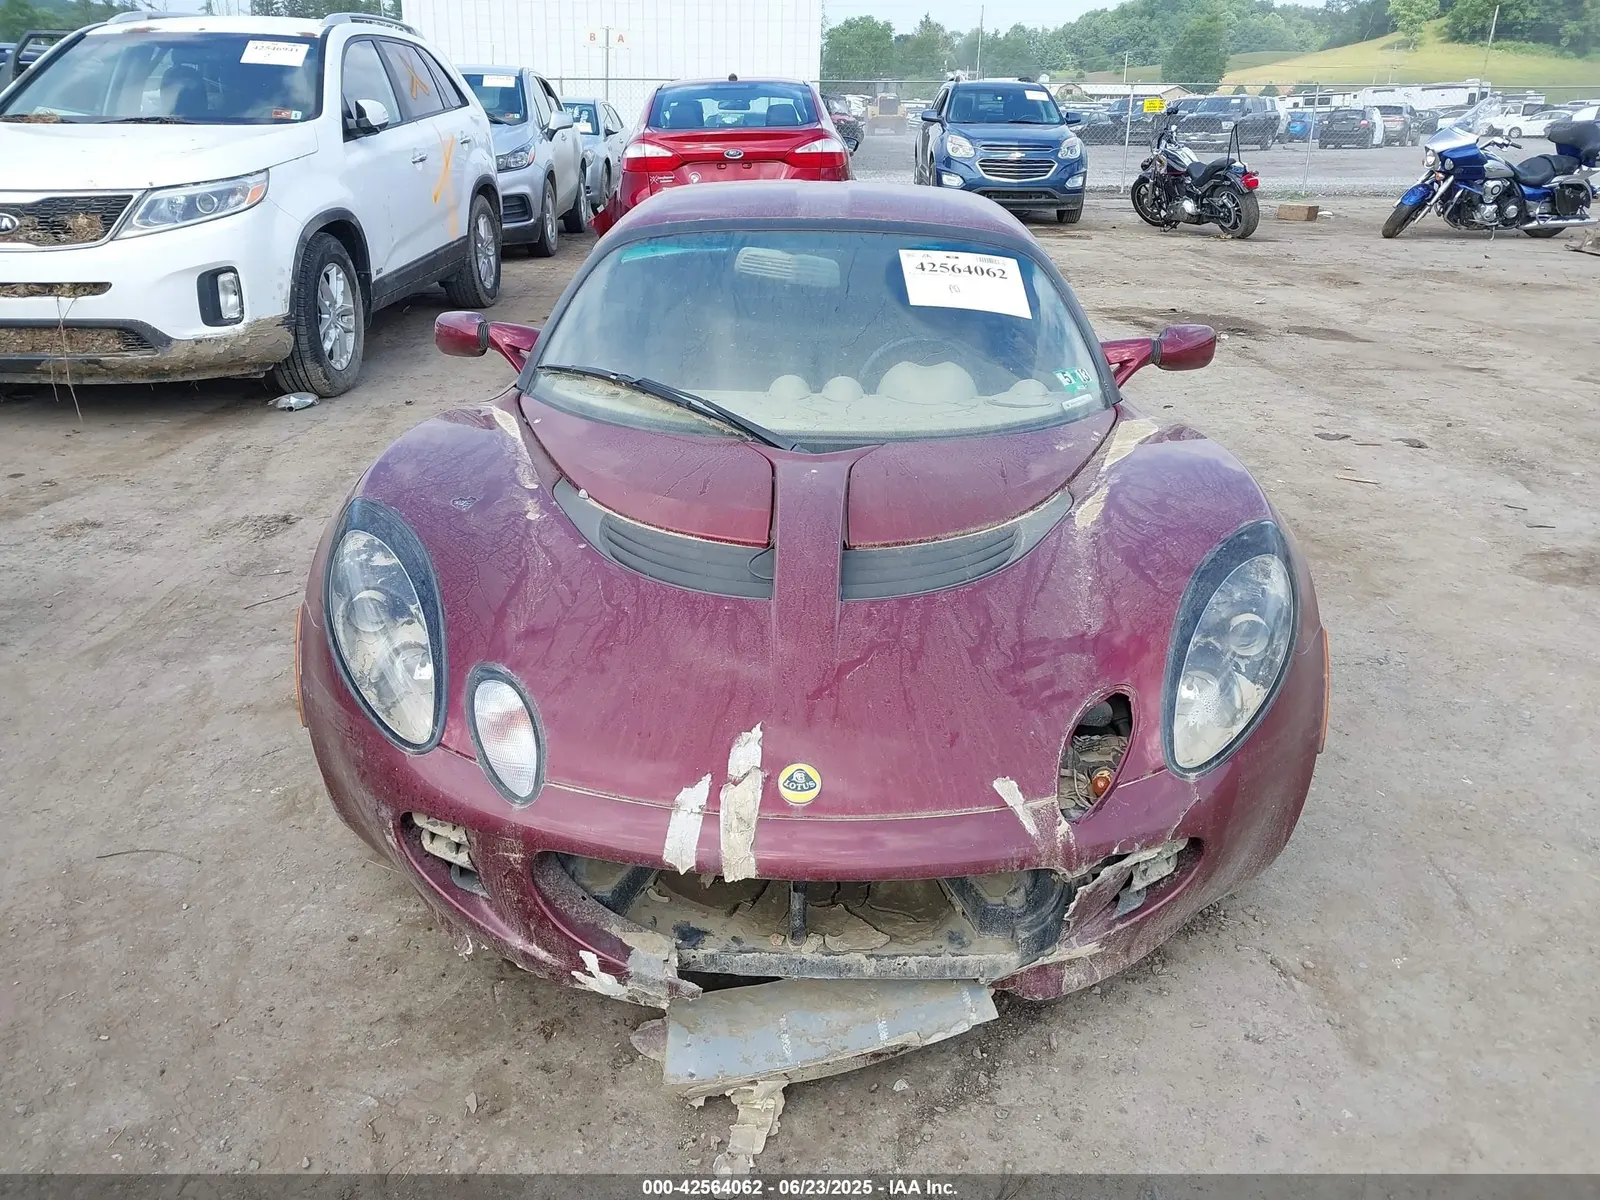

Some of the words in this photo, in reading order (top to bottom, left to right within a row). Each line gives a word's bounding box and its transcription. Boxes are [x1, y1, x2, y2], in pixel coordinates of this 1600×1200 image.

[589, 32, 596, 41] B
[617, 34, 624, 43] A
[915, 262, 1008, 280] 42564062
[1060, 371, 1072, 384] 5
[783, 780, 816, 790] LOTUS
